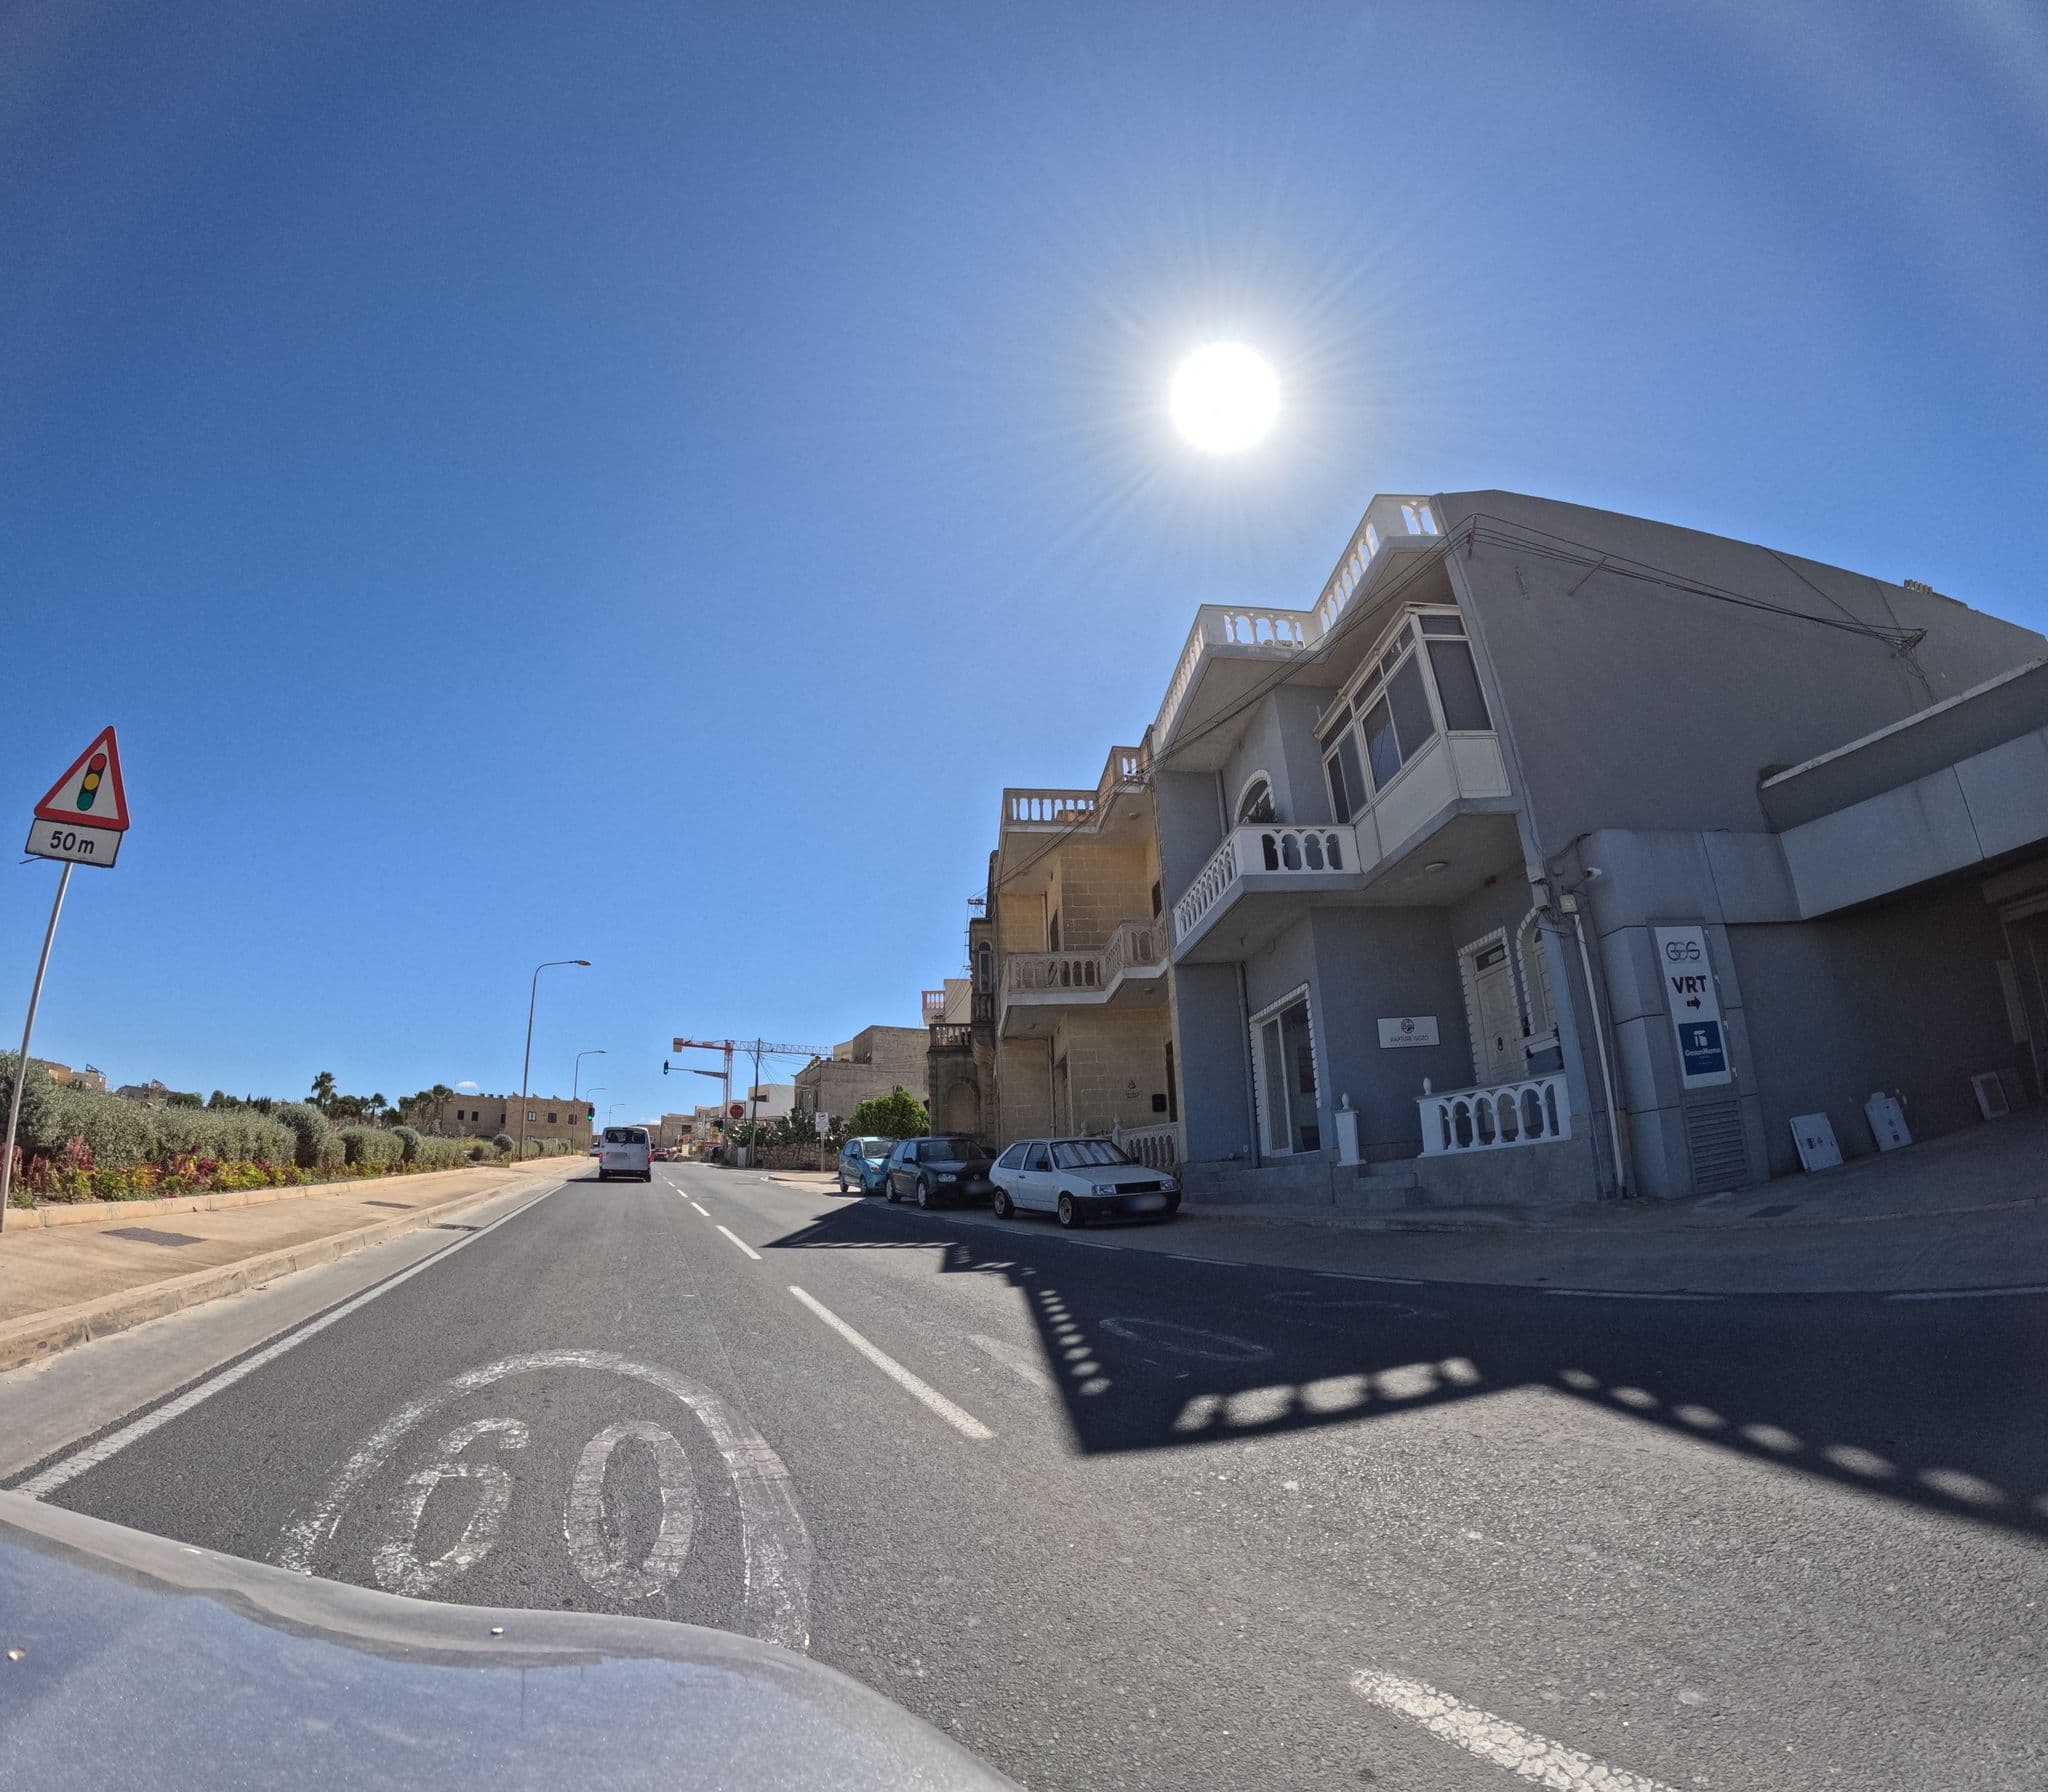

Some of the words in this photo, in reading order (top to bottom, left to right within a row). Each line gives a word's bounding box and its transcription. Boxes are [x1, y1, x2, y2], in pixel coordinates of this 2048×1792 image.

[50, 830, 76, 851] 50
[78, 839, 95, 854] m
[1671, 975, 1707, 994] VRT
[372, 1416, 694, 1600] 60
